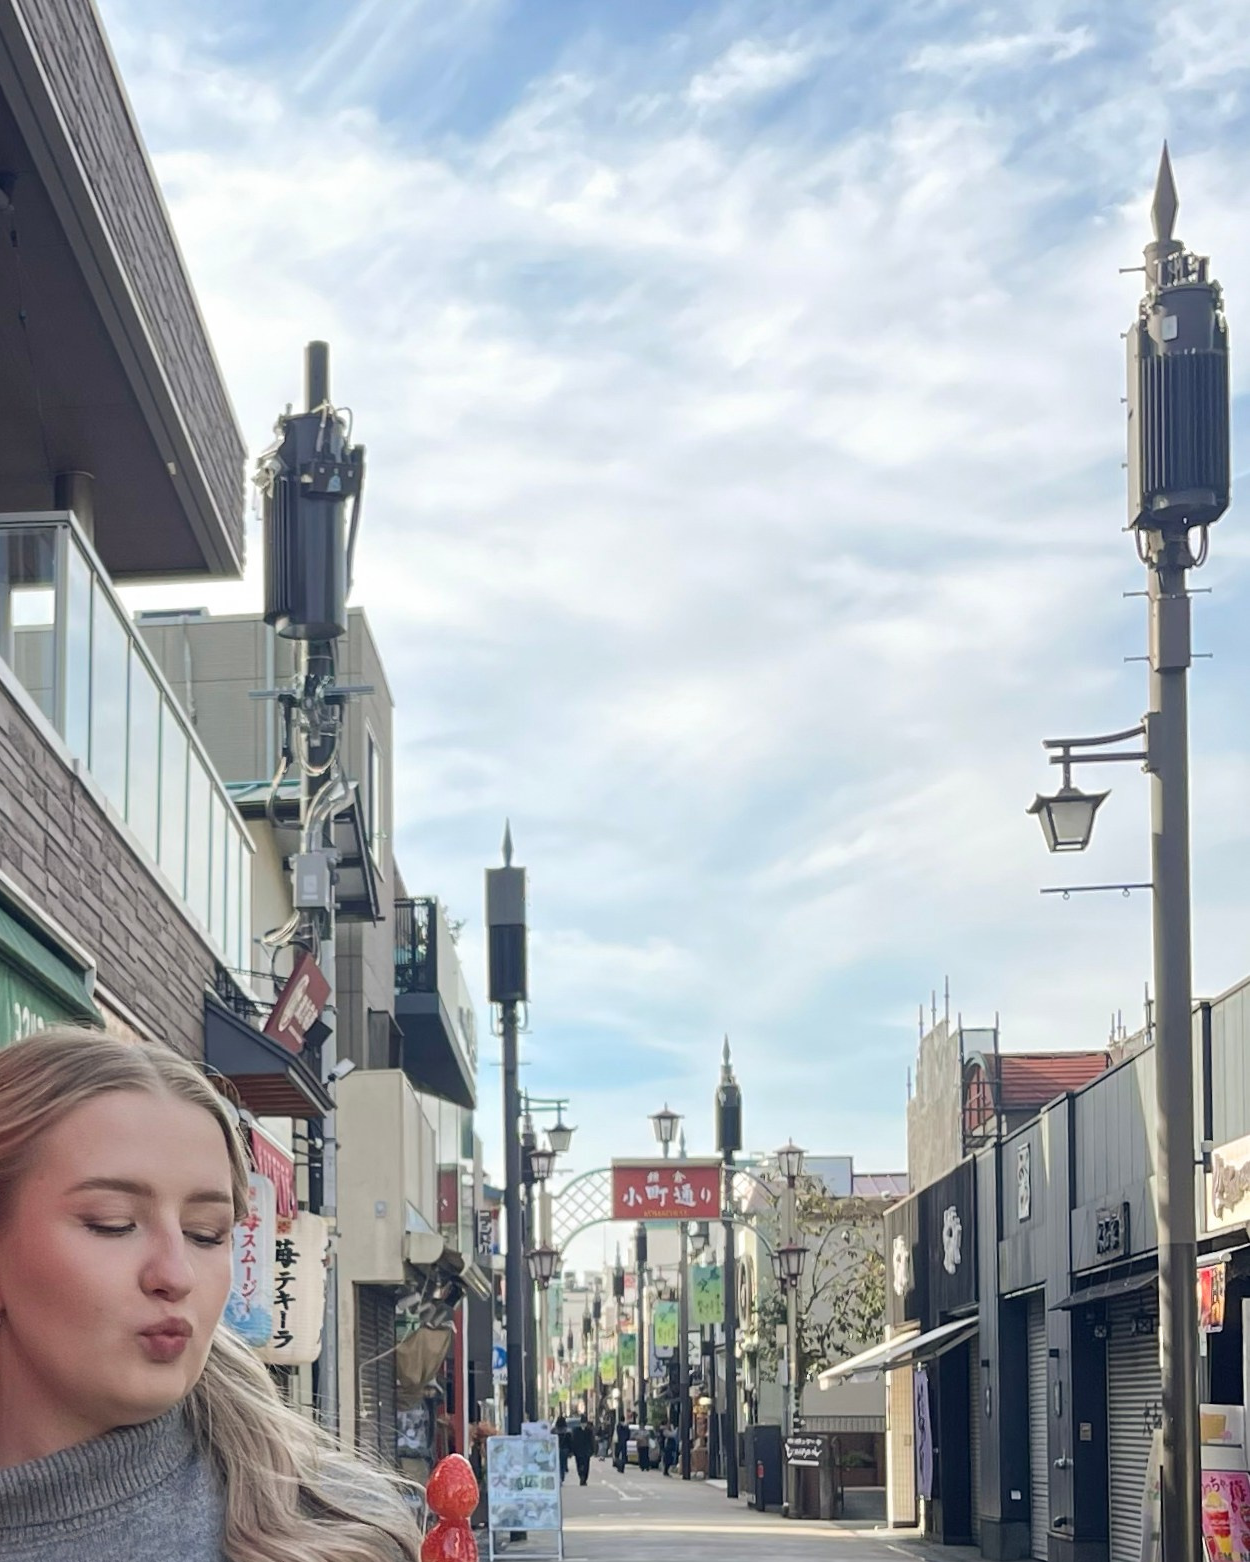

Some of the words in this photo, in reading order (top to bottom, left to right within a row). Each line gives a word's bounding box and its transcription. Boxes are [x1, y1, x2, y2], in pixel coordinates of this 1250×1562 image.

[622, 1183, 712, 1208] 小町通り
[273, 1238, 301, 1349] 苺テキーラ
